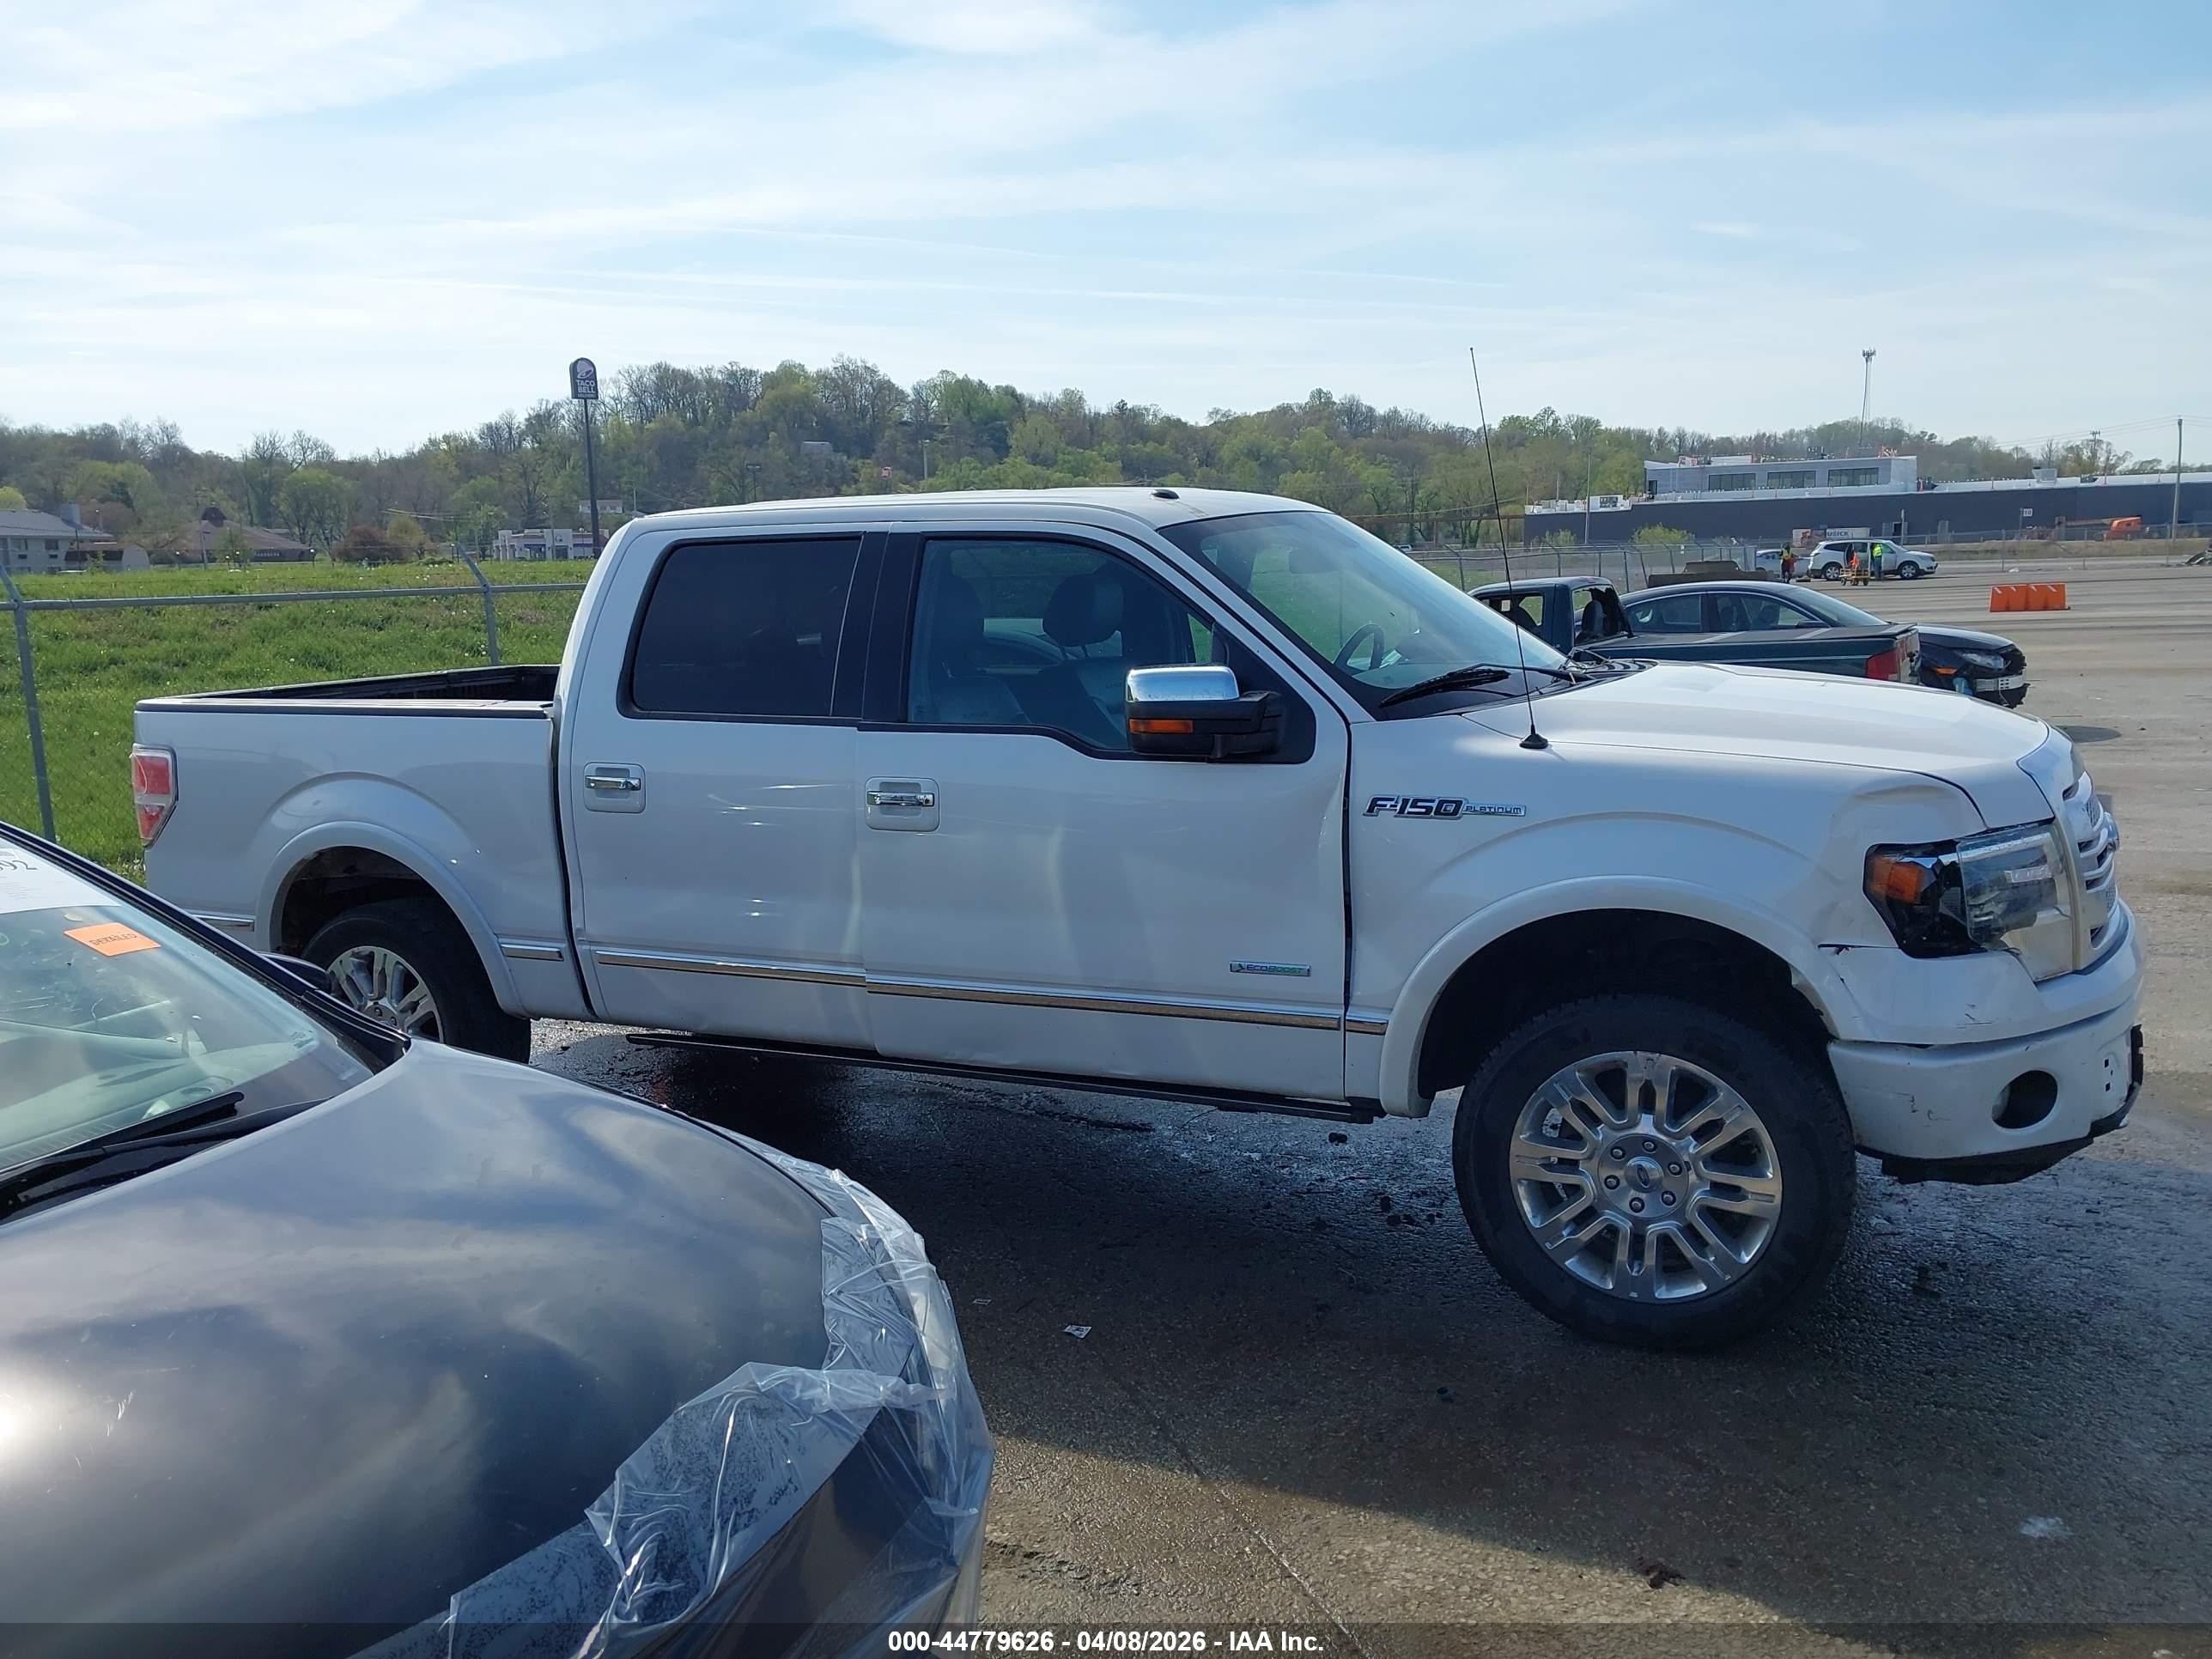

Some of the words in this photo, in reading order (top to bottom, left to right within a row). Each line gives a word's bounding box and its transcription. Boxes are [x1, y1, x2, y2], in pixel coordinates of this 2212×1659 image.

[1364, 795, 1467, 819] F-150
[1465, 805, 1522, 815] PLATINUM
[88, 933, 138, 945] DETAILED
